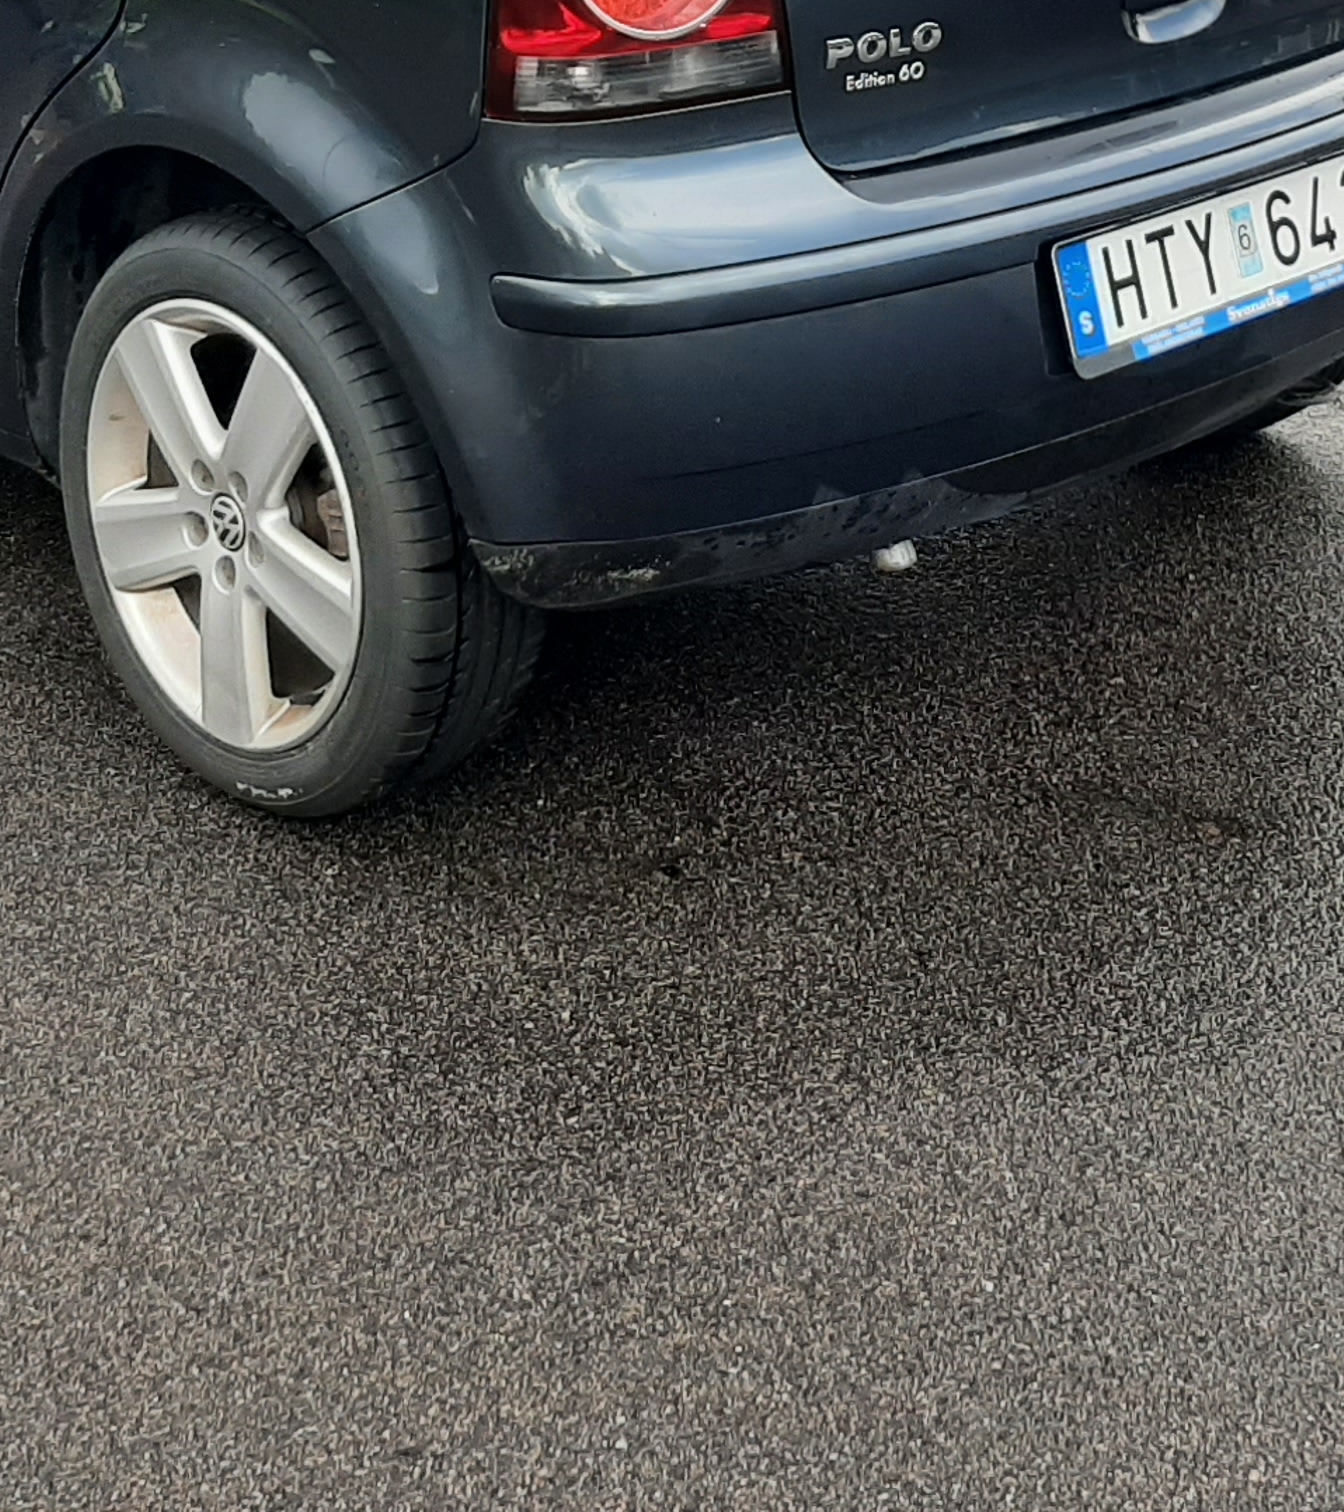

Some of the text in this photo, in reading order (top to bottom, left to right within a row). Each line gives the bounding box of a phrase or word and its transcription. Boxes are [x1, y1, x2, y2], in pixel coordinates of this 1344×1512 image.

[825, 21, 943, 70] POLO
[846, 61, 925, 92] Edition 60
[1237, 222, 1252, 252] 6
[1101, 212, 1217, 328] HTY
[1077, 310, 1095, 336] S
